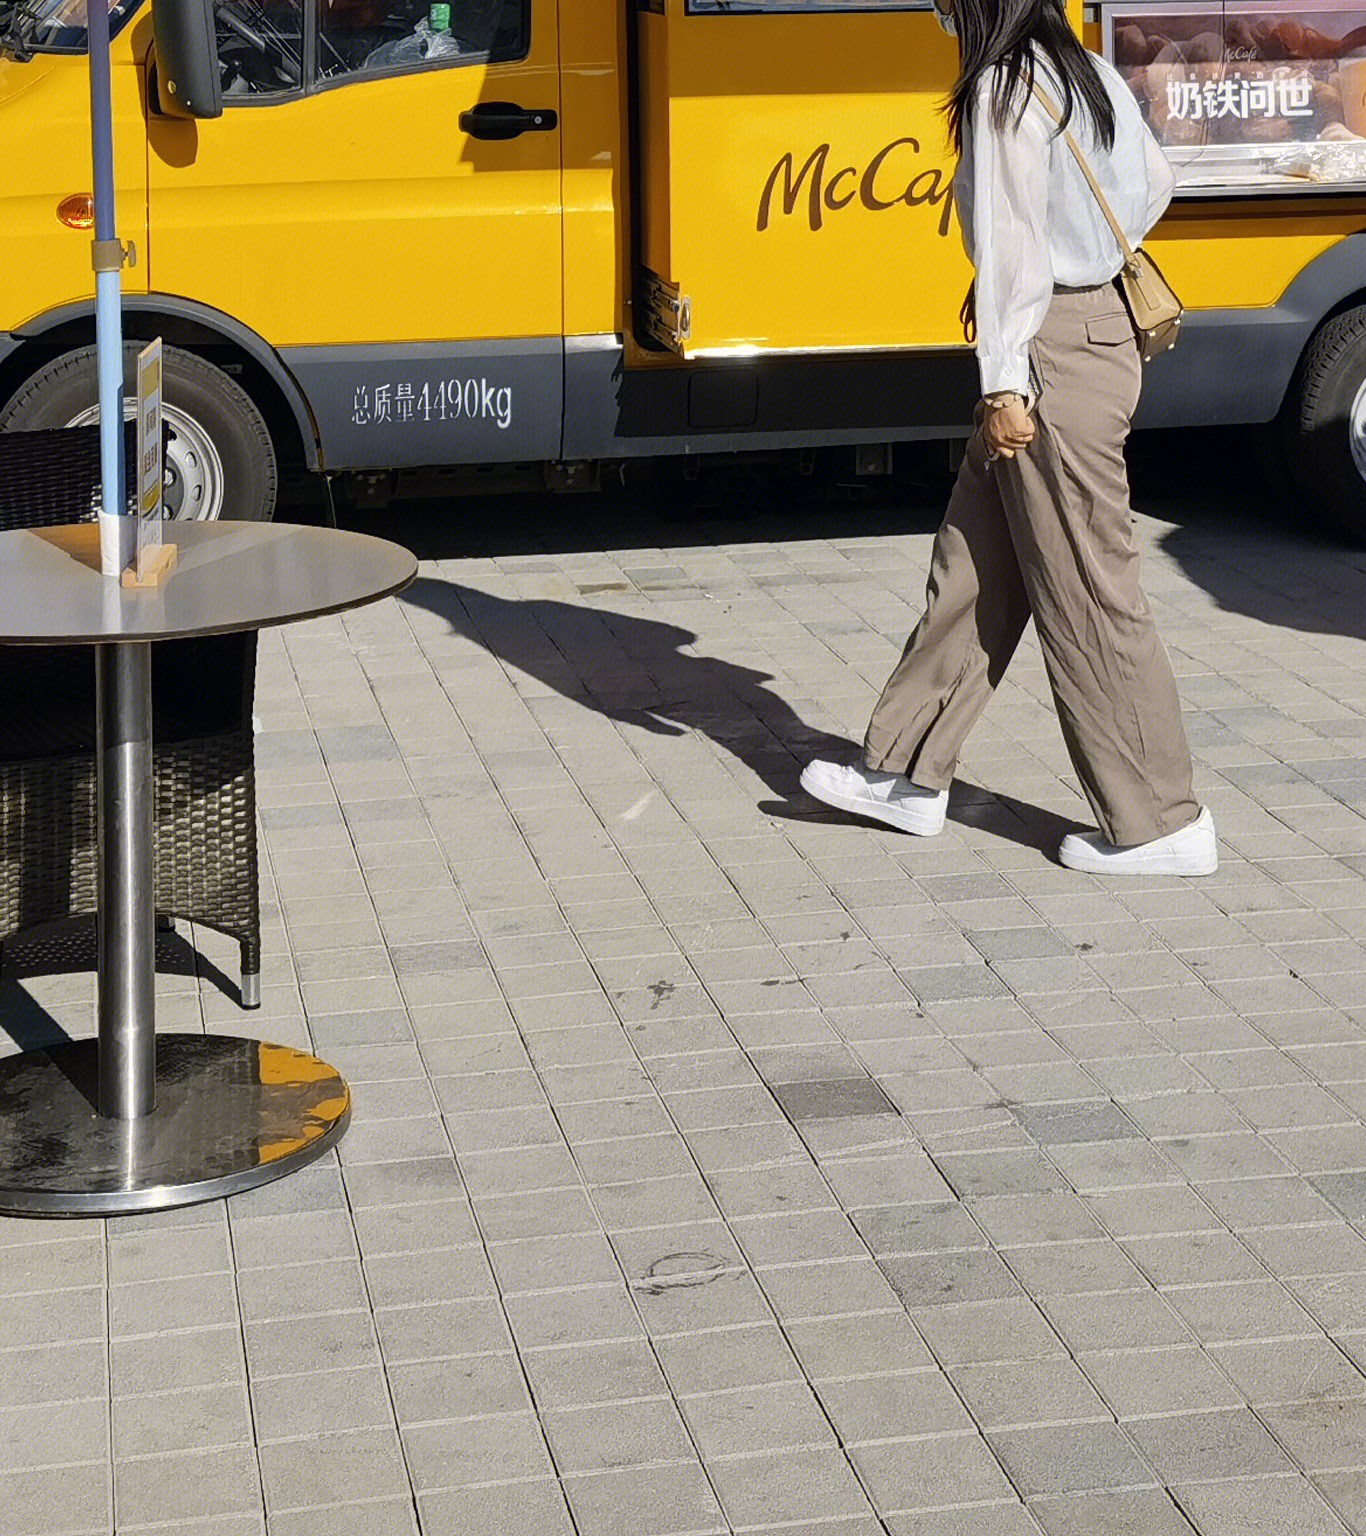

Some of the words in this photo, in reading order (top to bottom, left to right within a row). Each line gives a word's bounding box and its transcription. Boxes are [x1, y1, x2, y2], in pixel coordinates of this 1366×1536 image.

[1165, 78, 1314, 120] 奶铁问世
[351, 377, 512, 429] 总质量4490kg
